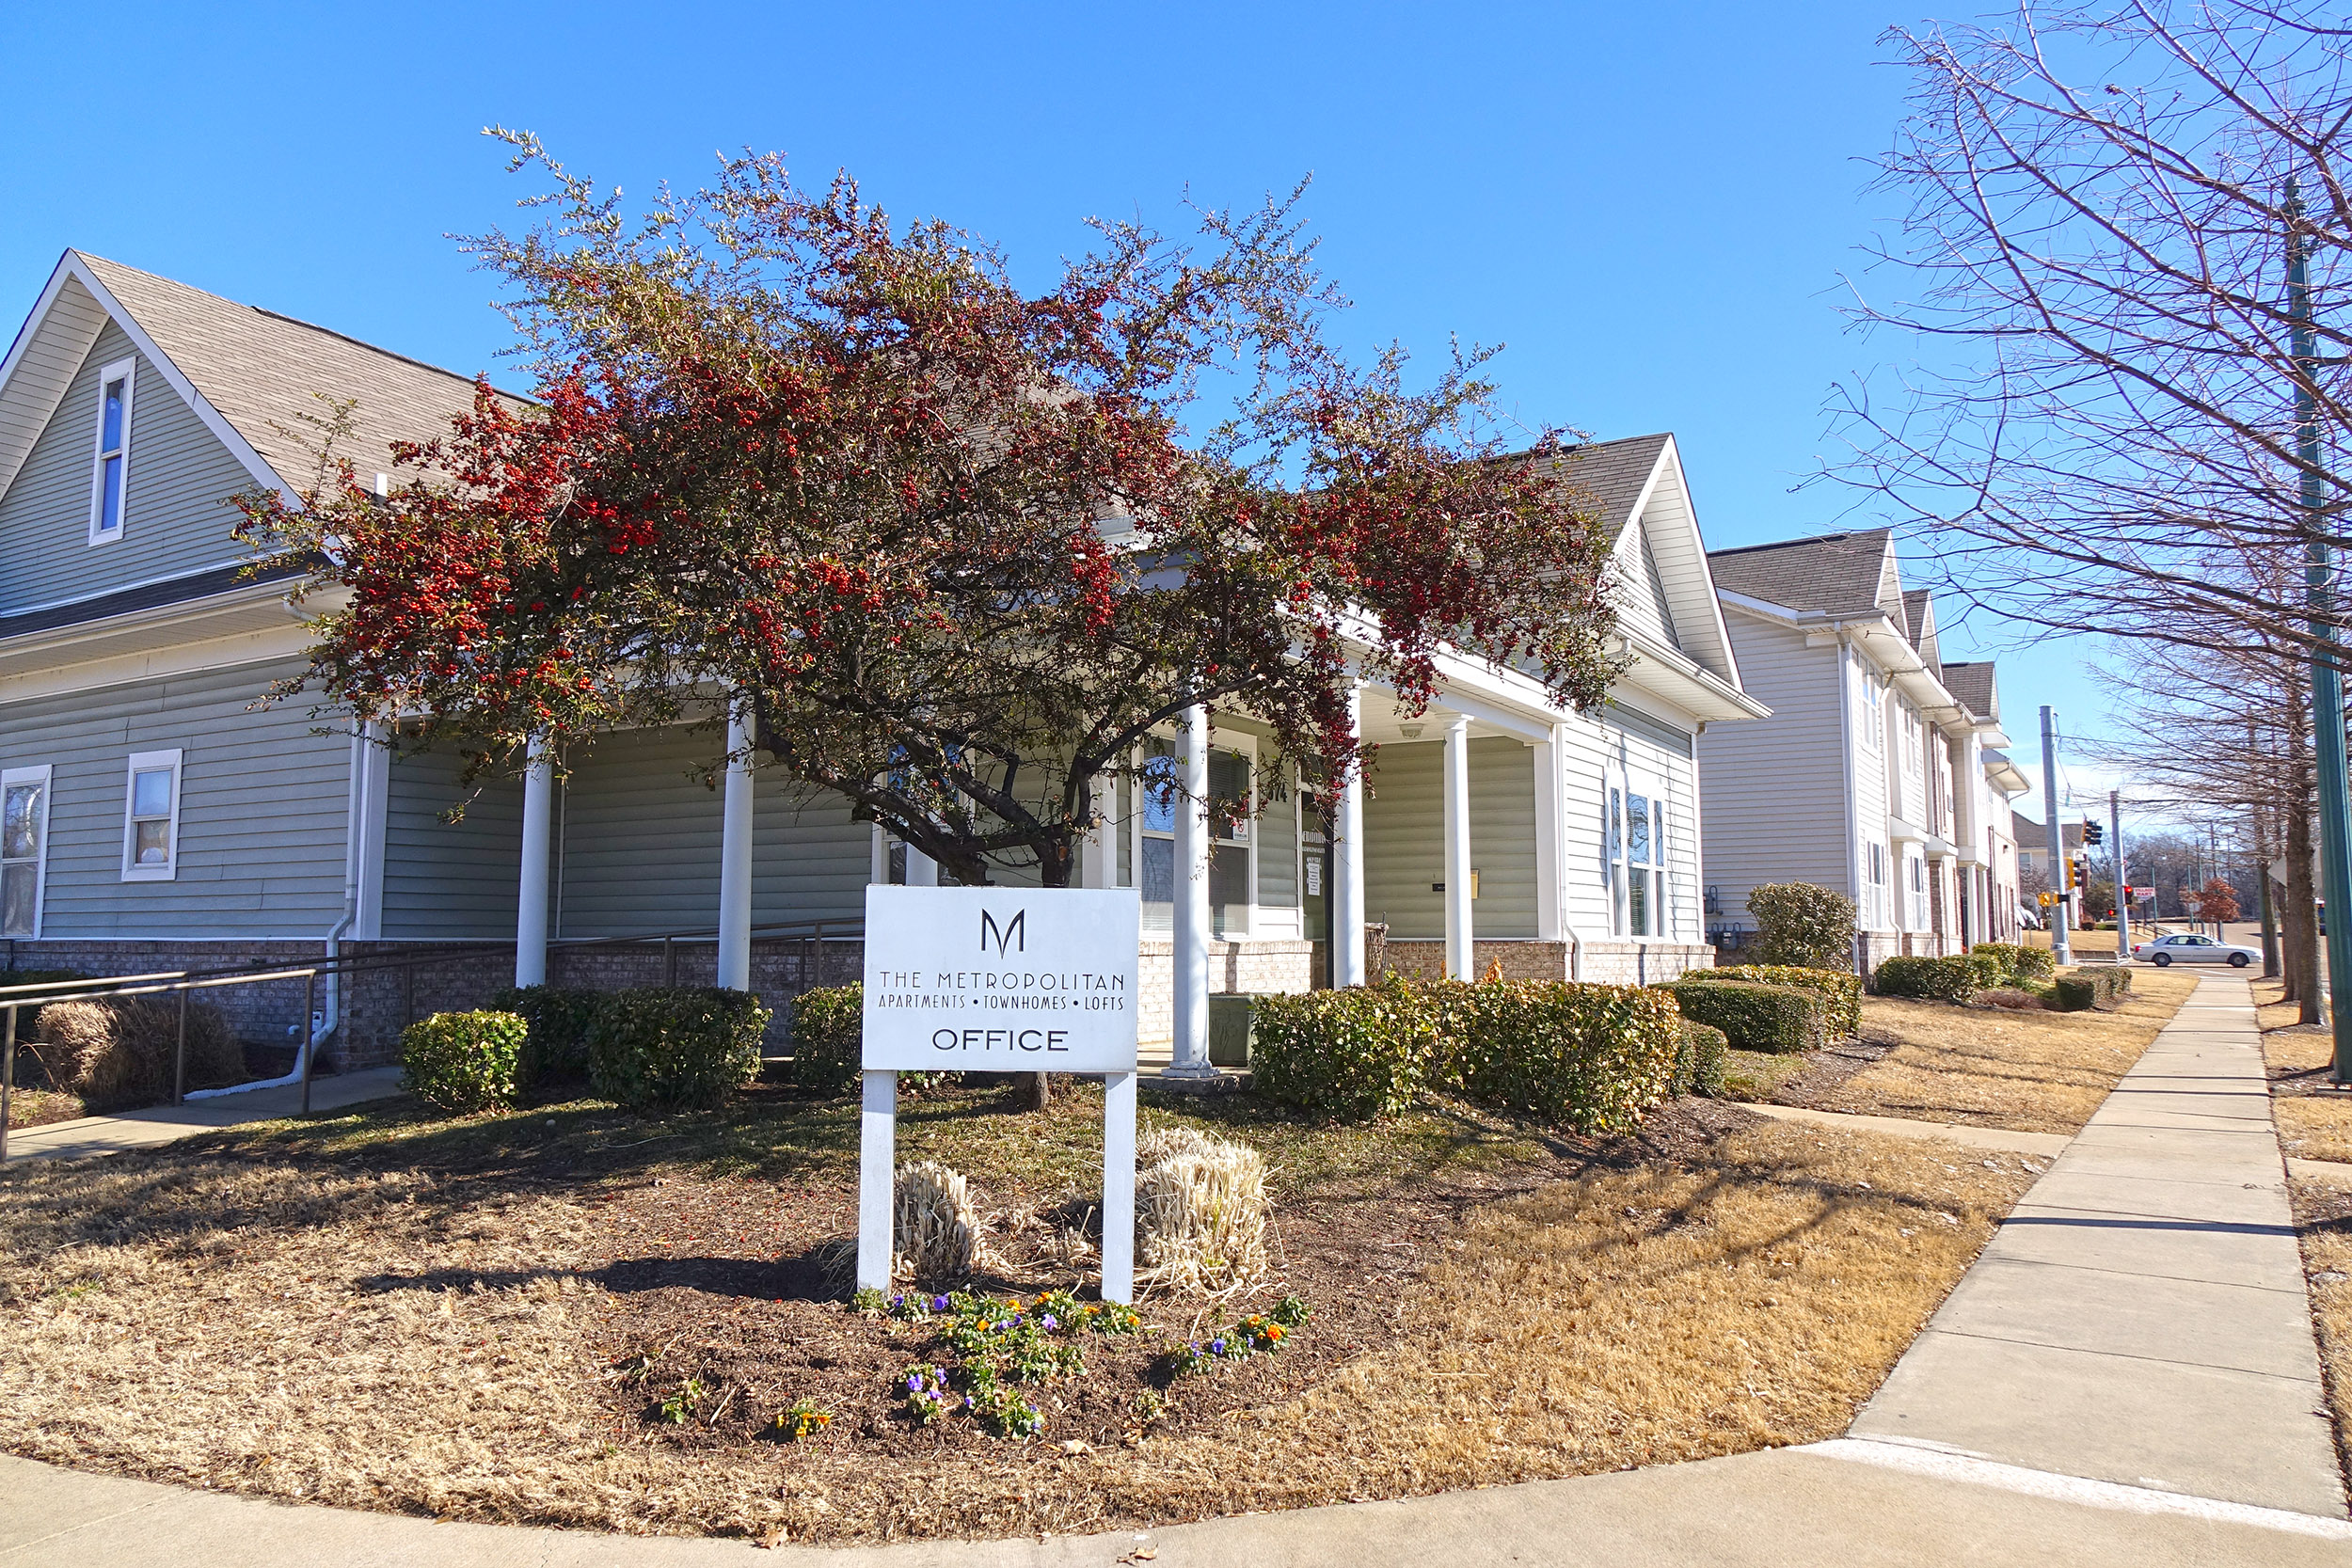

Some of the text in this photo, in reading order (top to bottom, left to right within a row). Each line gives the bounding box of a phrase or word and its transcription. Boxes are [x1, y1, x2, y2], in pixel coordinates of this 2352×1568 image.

[980, 908, 1025, 960] M
[880, 971, 1124, 991] THE METROPOLITAN
[878, 993, 1124, 1011] APARTMENTS TOWNHOMES LOFTS
[932, 1028, 1069, 1052] OFFICE
